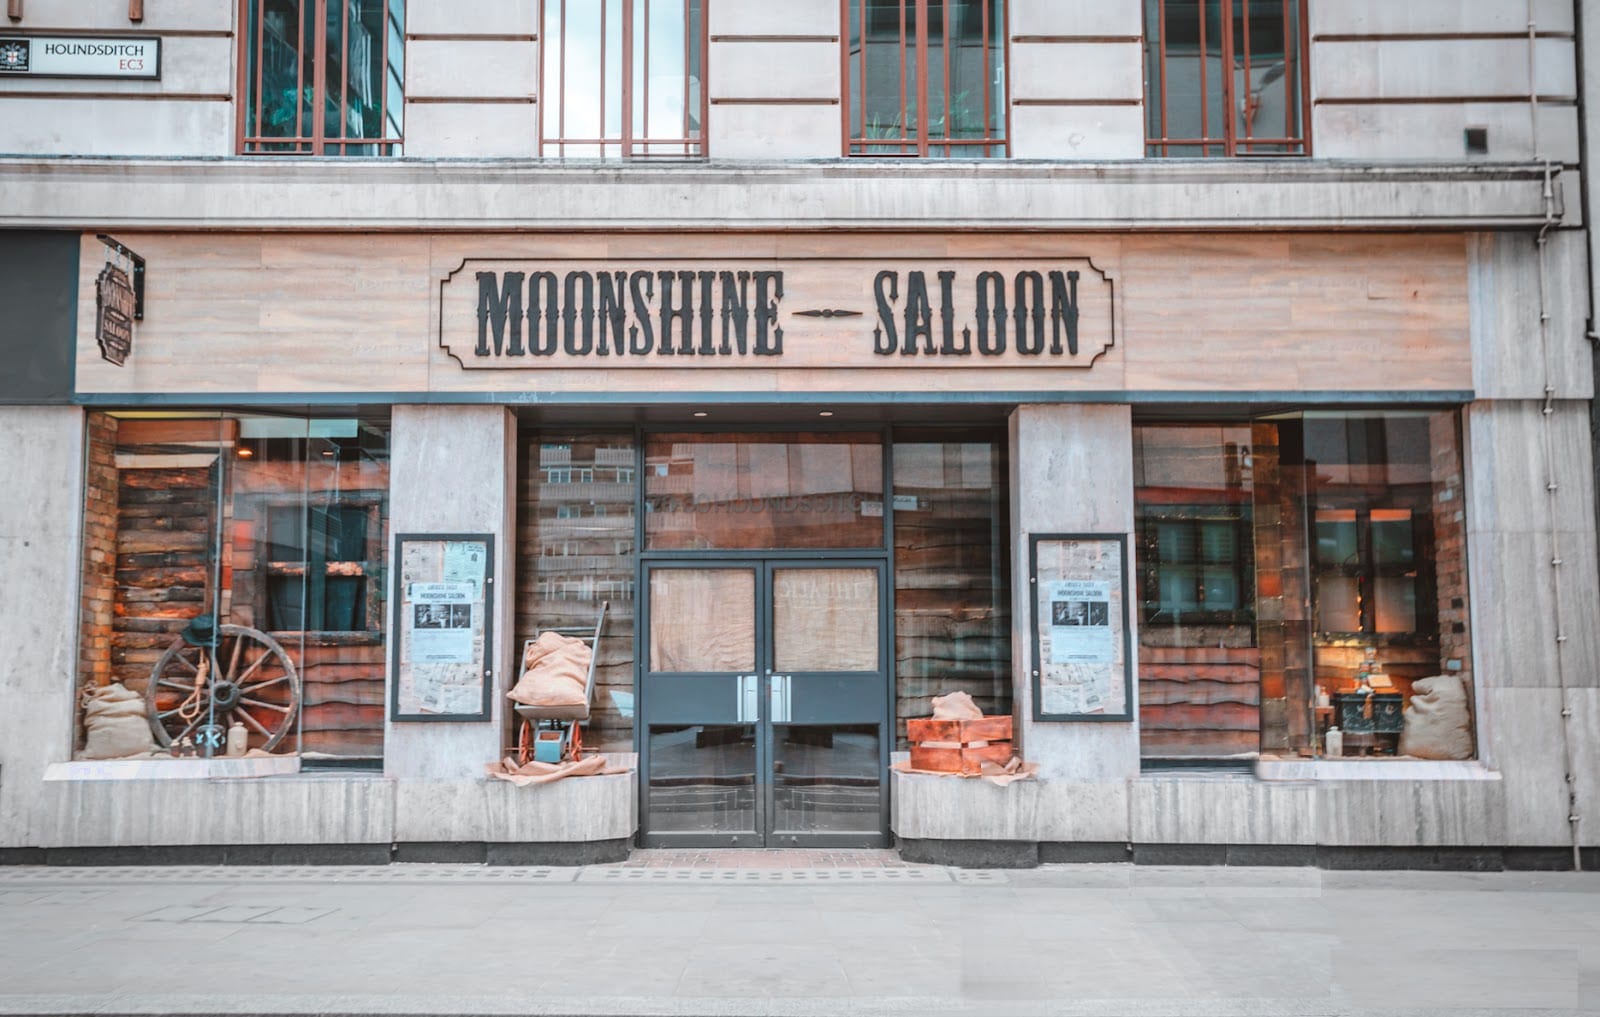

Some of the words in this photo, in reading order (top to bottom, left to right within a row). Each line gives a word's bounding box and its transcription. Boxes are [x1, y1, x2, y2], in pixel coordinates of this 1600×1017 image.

[45, 44, 144, 56] HOUNDSDITCH
[119, 59, 144, 70] EC3
[475, 271, 783, 357] MOONSHINE
[874, 271, 1079, 356] SALOON
